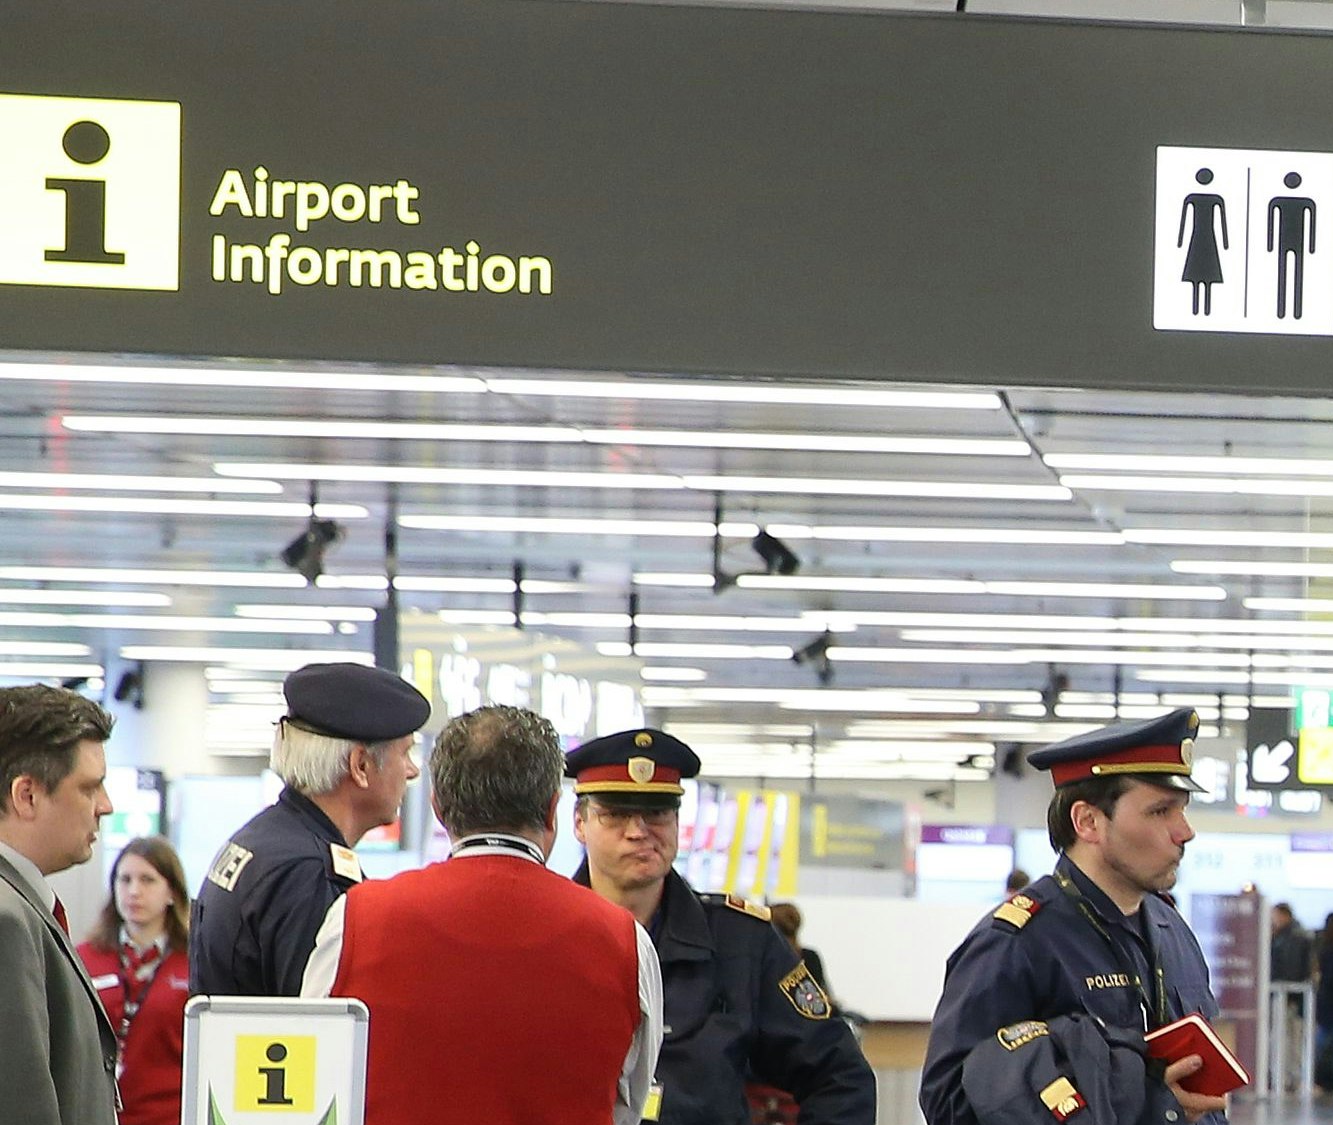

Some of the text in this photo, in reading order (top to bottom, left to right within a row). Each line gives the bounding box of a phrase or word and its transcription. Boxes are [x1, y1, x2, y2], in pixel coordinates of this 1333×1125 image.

[209, 166, 420, 231] Airport
[211, 234, 553, 294] Information
[1085, 973, 1130, 991] POLIZEI
